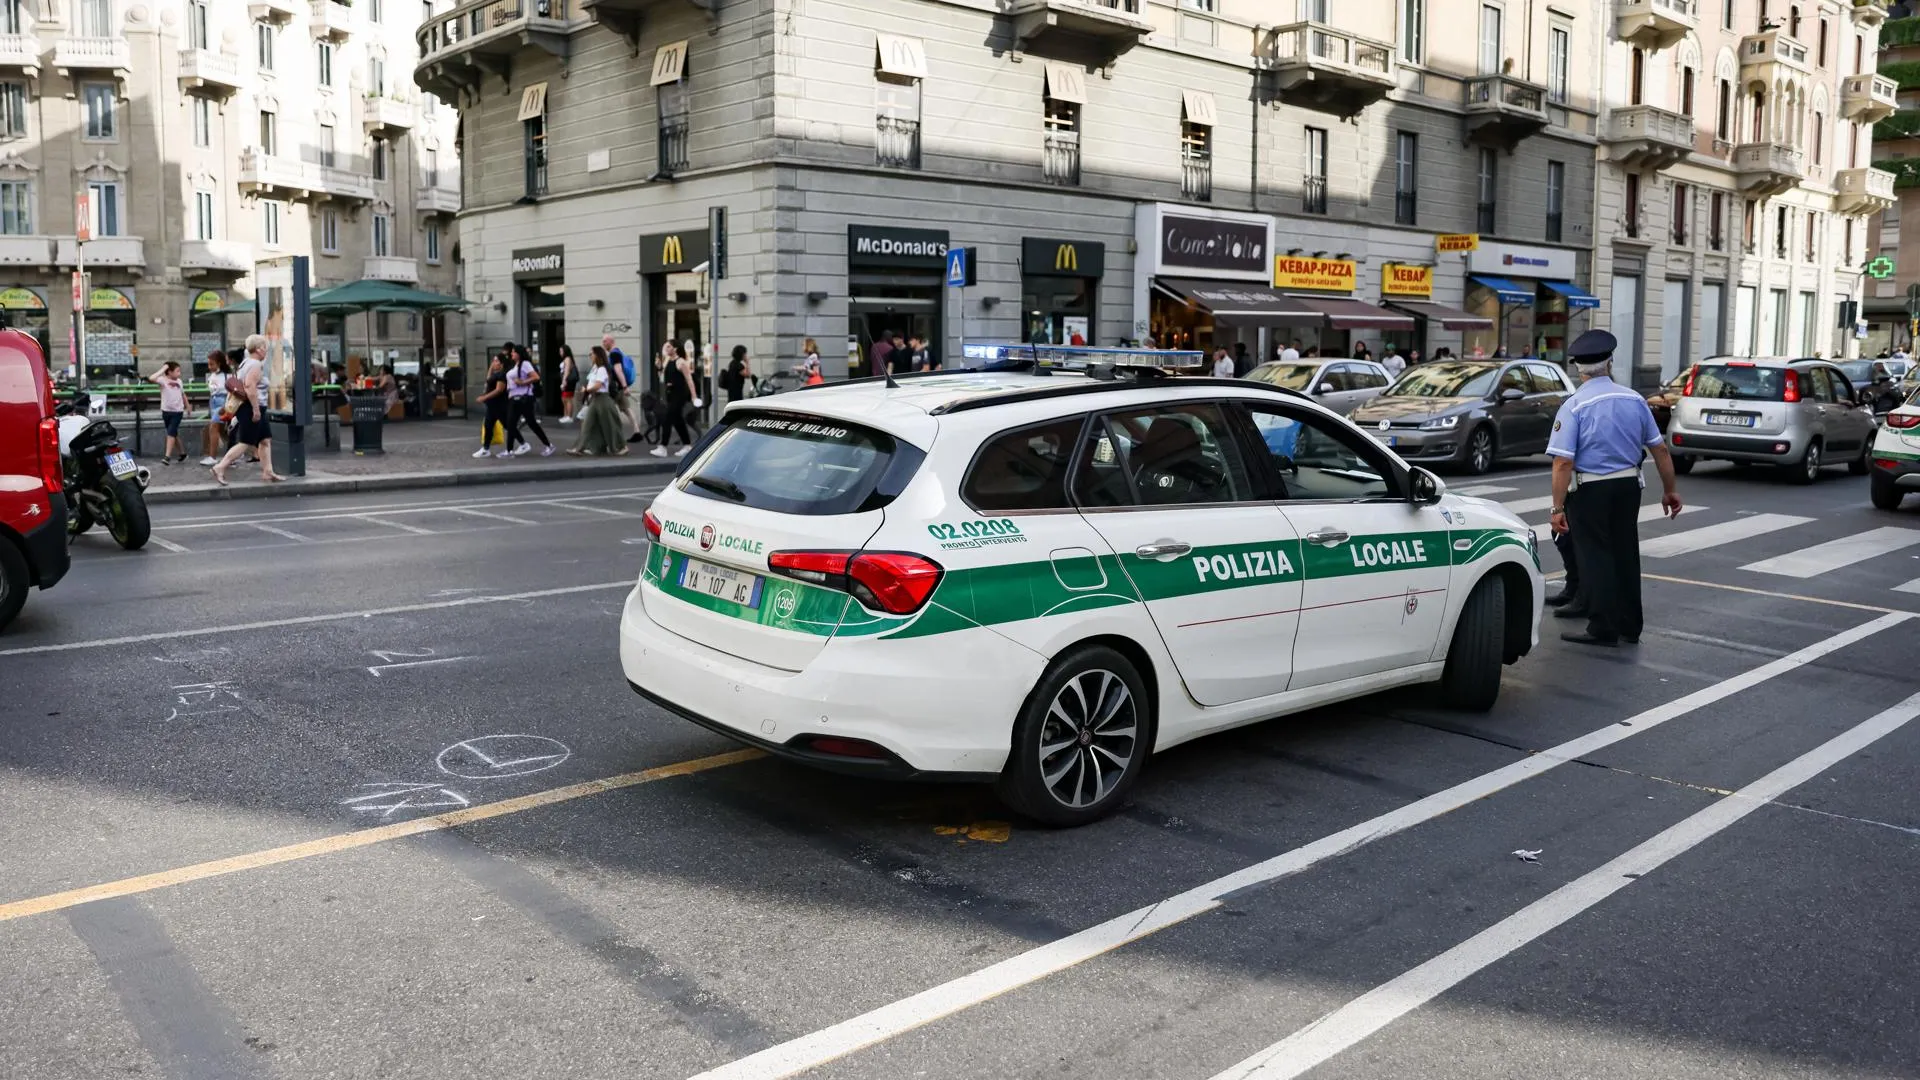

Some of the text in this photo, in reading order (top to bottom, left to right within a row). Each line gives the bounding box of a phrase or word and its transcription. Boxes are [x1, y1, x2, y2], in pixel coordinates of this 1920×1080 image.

[856, 237, 947, 257] McDonald's
[1439, 241, 1473, 251] KEBAP
[512, 254, 561, 272] McDonald's
[1279, 259, 1353, 278] KEBAP-PIZZA
[1393, 268, 1426, 281] KEBAP
[747, 418, 848, 439] COMUNE di MILANO
[664, 520, 696, 540] POLIZIA
[927, 518, 1020, 540] 02.0208
[718, 534, 764, 555] LOCALE
[941, 536, 1028, 550] PRONTO INTERVENTO
[1192, 539, 1428, 583] POLIZIA LOCALE
[688, 570, 748, 603] YA 107 AG
[776, 594, 794, 612] 1205
